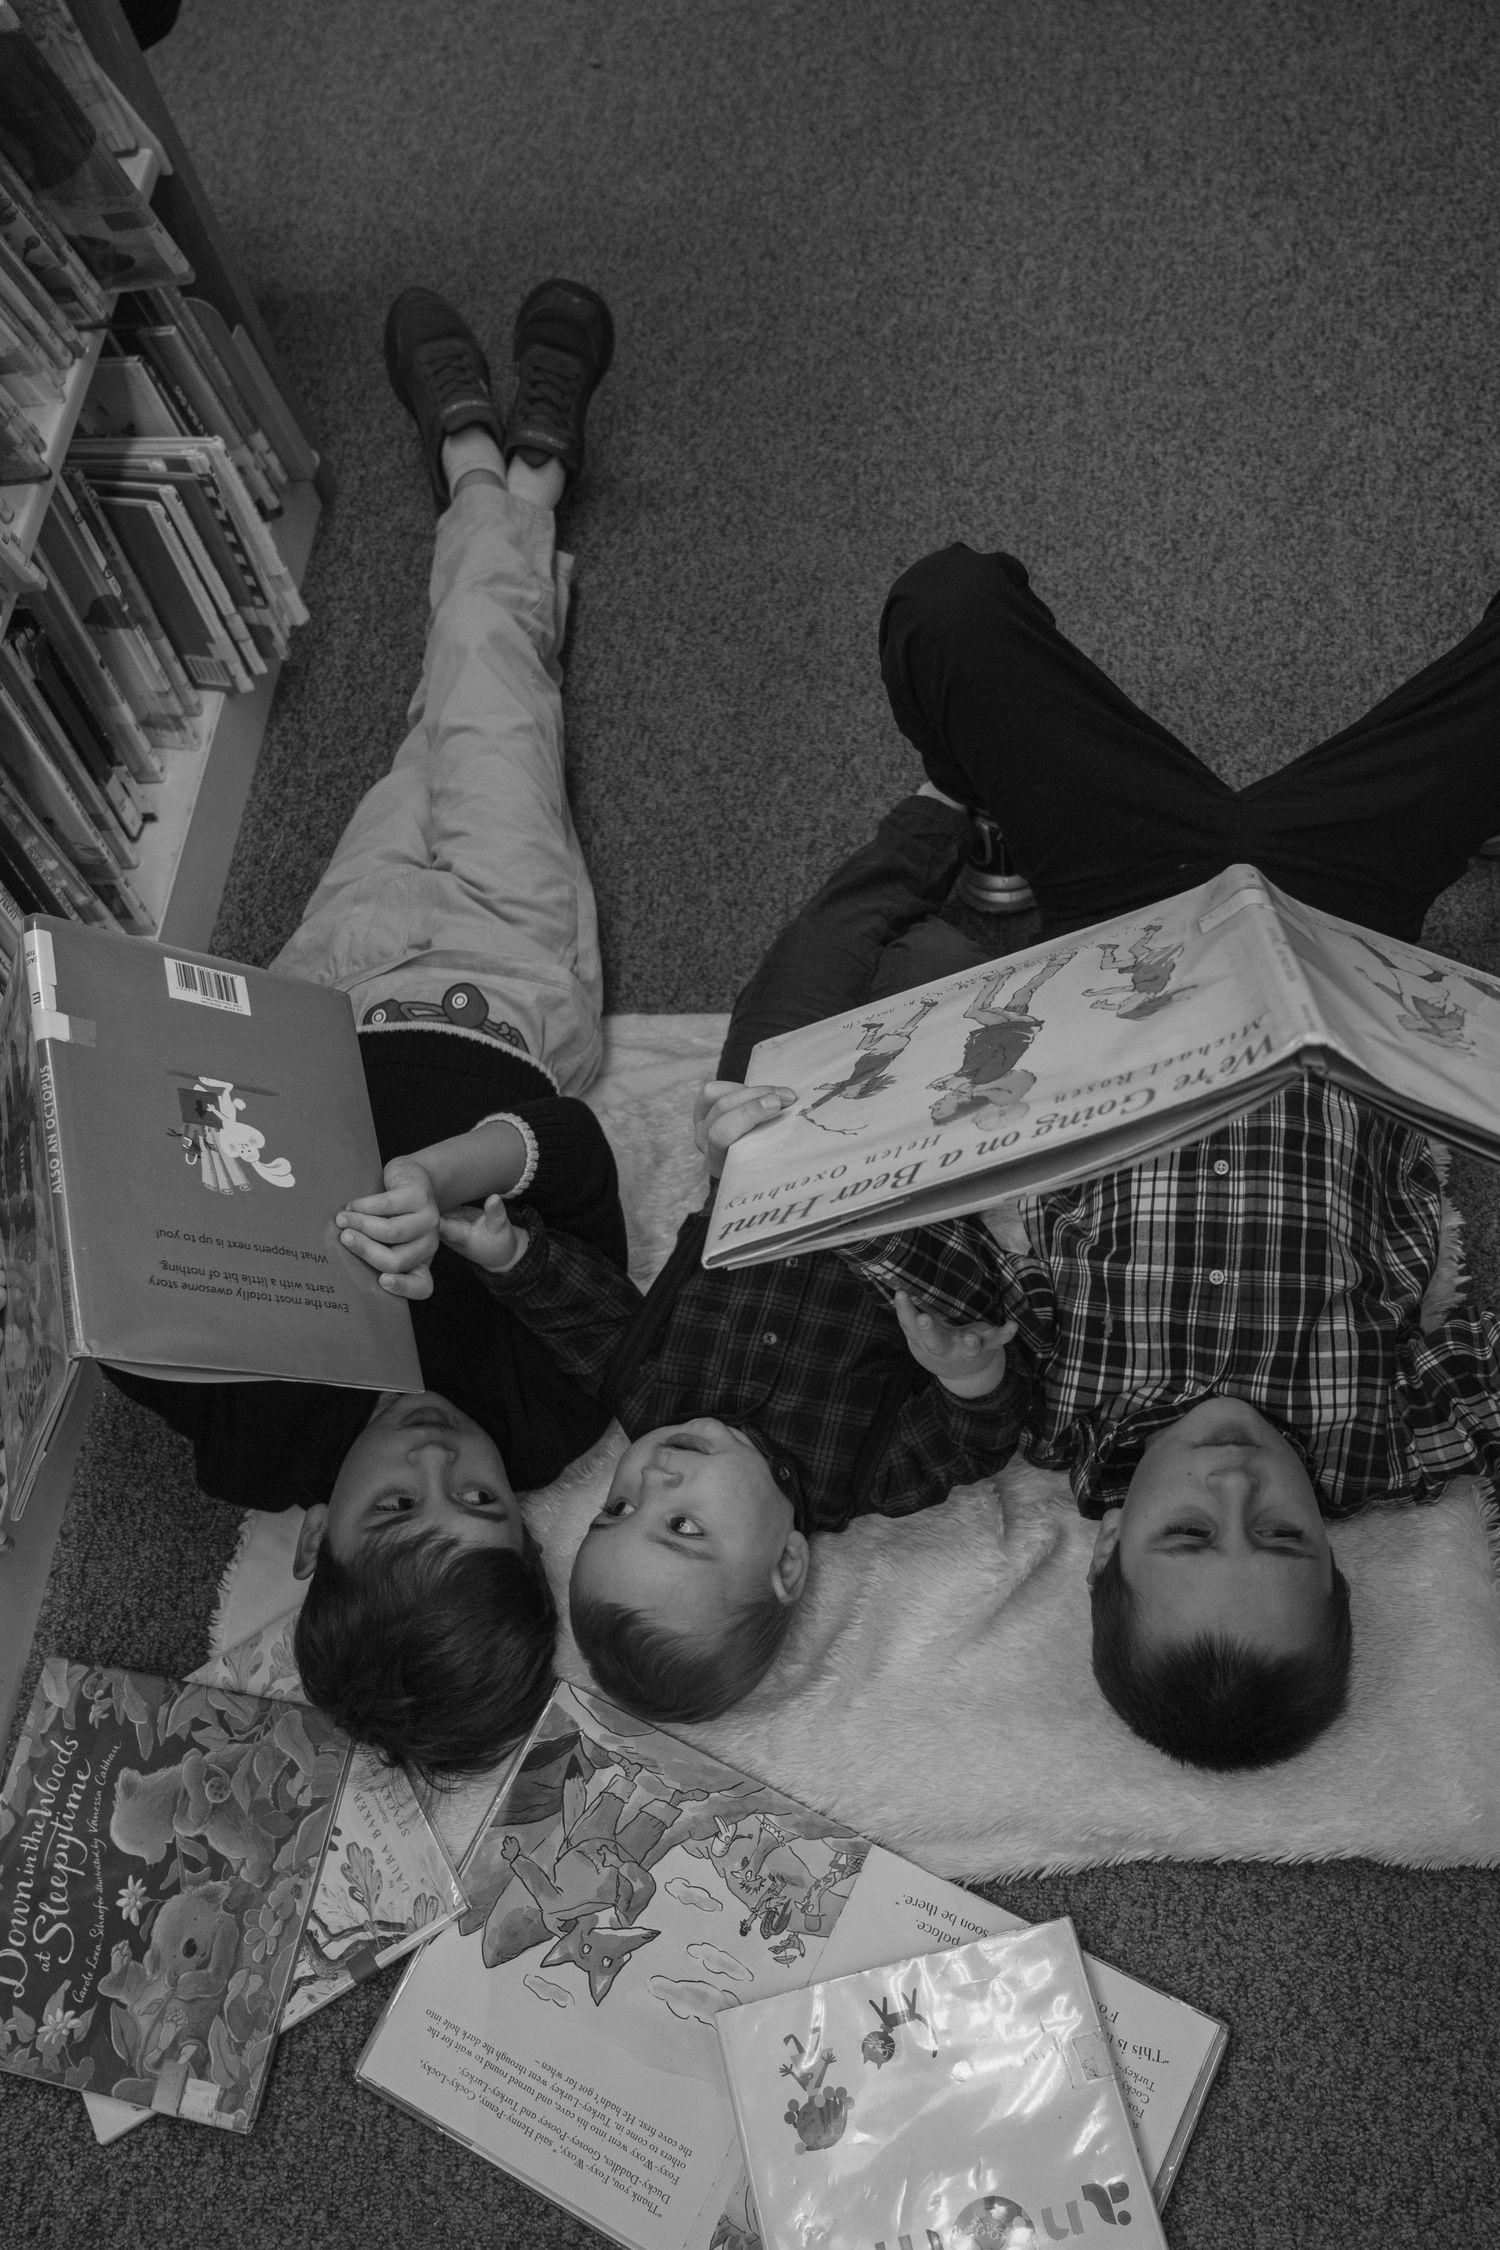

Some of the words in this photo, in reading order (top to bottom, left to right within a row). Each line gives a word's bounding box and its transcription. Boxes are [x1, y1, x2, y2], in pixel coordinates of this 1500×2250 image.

[1151, 1015, 1262, 1075] Michael
[1174, 1034, 1273, 1090] We're
[39, 1063, 55, 1129] OCTOPUS
[1055, 1072, 1133, 1103] Rosen
[1035, 1088, 1156, 1137] Going
[46, 1132, 59, 1153] AN
[865, 1134, 941, 1164] Helen
[977, 1131, 1020, 1155] on
[940, 1150, 963, 1167] a
[48, 1157, 63, 1193] ALSO
[830, 1162, 922, 1203] Bear
[724, 1165, 847, 1210] Oxenbury
[718, 1195, 820, 1240] Hunt
[156, 1229, 181, 1239] you!
[183, 1233, 195, 1243] to
[198, 1233, 213, 1244] up
[216, 1238, 224, 1246] is
[227, 1240, 251, 1250] next
[253, 1244, 298, 1260] happens
[301, 1251, 328, 1264] What
[159, 1259, 205, 1277] nothing.
[208, 1270, 220, 1280] of
[223, 1272, 238, 1281] bit
[149, 1275, 178, 1289] story
[181, 1282, 233, 1295] awesome
[241, 1274, 268, 1287] little
[270, 1278, 276, 1286] a
[279, 1280, 303, 1290] with
[305, 1283, 335, 1294] starts
[236, 1287, 272, 1302] totally
[275, 1295, 302, 1304] most
[305, 1298, 322, 1309] the
[324, 1301, 349, 1313] Even
[28, 1735, 79, 1817] Woods
[86, 1791, 101, 1832] Vanessa
[353, 1792, 382, 1839] BAKER
[20, 1815, 46, 1853] the
[90, 1838, 107, 1850] by
[17, 1851, 34, 1875] in
[33, 1760, 91, 1964] Sleepytime
[381, 1844, 410, 1893] LAURA
[89, 1896, 108, 1937] Schaefer
[941, 1911, 957, 1926] be
[960, 1918, 989, 1938] soon
[0, 1879, 34, 1998] Down
[34, 1952, 51, 1972] at
[86, 1943, 102, 1969] Lexa
[72, 1972, 93, 2003] Carole
[426, 2009, 442, 2025] into
[1096, 1999, 1121, 2025] Fo
[427, 2026, 440, 2038] the
[443, 2019, 461, 2036] hole
[440, 2035, 454, 2048] for
[462, 2030, 481, 2047] dark
[454, 2042, 472, 2057] wait
[482, 2042, 495, 2055] the
[475, 2055, 484, 2063] to
[496, 2051, 527, 2075] through
[483, 2060, 508, 2078] round
[541, 2062, 562, 2079] when
[1113, 2062, 1157, 2093] Turkey-
[420, 2060, 476, 2100] Cocky-Locky,
[507, 2075, 535, 2096] turned
[528, 2071, 547, 2086] went
[564, 2076, 578, 2090] far
[459, 2067, 518, 2112] Turkey-Lurkey.
[579, 2084, 595, 2096] got
[535, 2092, 553, 2105] and
[549, 2082, 611, 2128] Turkey-Lurkey
[594, 2093, 622, 2117] hadn't
[479, 2095, 534, 2138] Henny-Penny,
[519, 2106, 537, 2119] and
[555, 2102, 575, 2119] cave,
[1122, 2098, 1147, 2120] Fox
[577, 2116, 589, 2130] his
[622, 2111, 636, 2125] He
[590, 2125, 607, 2142] into
[614, 2122, 625, 2135] in.
[639, 2119, 657, 2137] first.
[534, 2132, 553, 2146] said
[537, 2116, 601, 2161] Goosey-Poosey
[608, 2136, 627, 2152] went
[626, 2129, 648, 2146] come
[658, 2132, 677, 2146] cave
[649, 2144, 658, 2153] to
[678, 2144, 692, 2158] the
[630, 2148, 680, 2186] Foxy-Woxy
[660, 2150, 686, 2169] others
[604, 2155, 671, 2205] Ducky-Daddles,
[613, 2178, 632, 2194] you,
